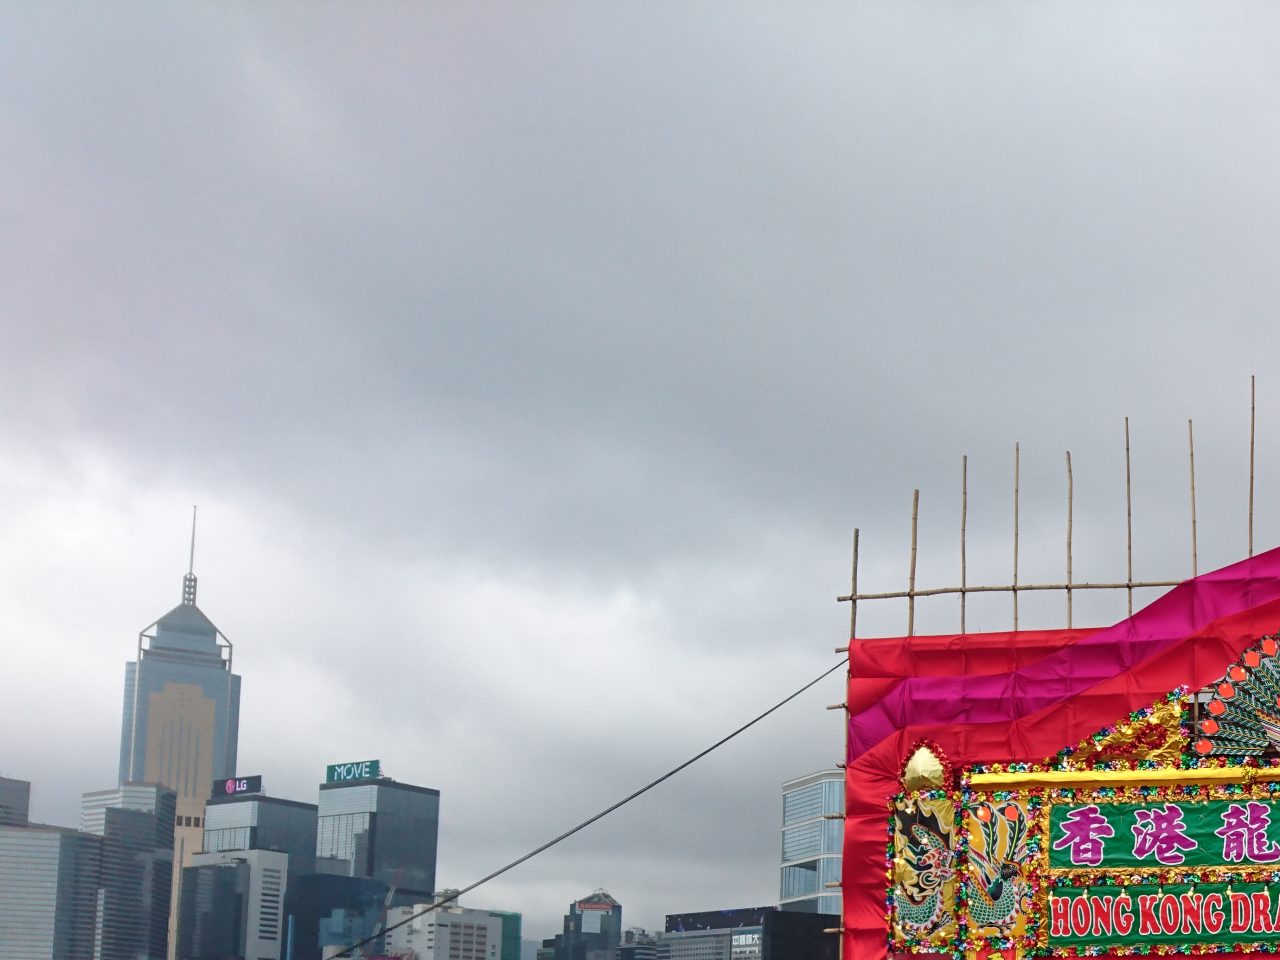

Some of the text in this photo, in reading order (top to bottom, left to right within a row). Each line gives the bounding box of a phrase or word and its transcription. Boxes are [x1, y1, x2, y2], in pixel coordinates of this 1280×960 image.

[333, 762, 371, 781] MOVE
[235, 779, 247, 791] LG
[1050, 896, 1133, 937] HONG
[1138, 893, 1226, 936] KONG
